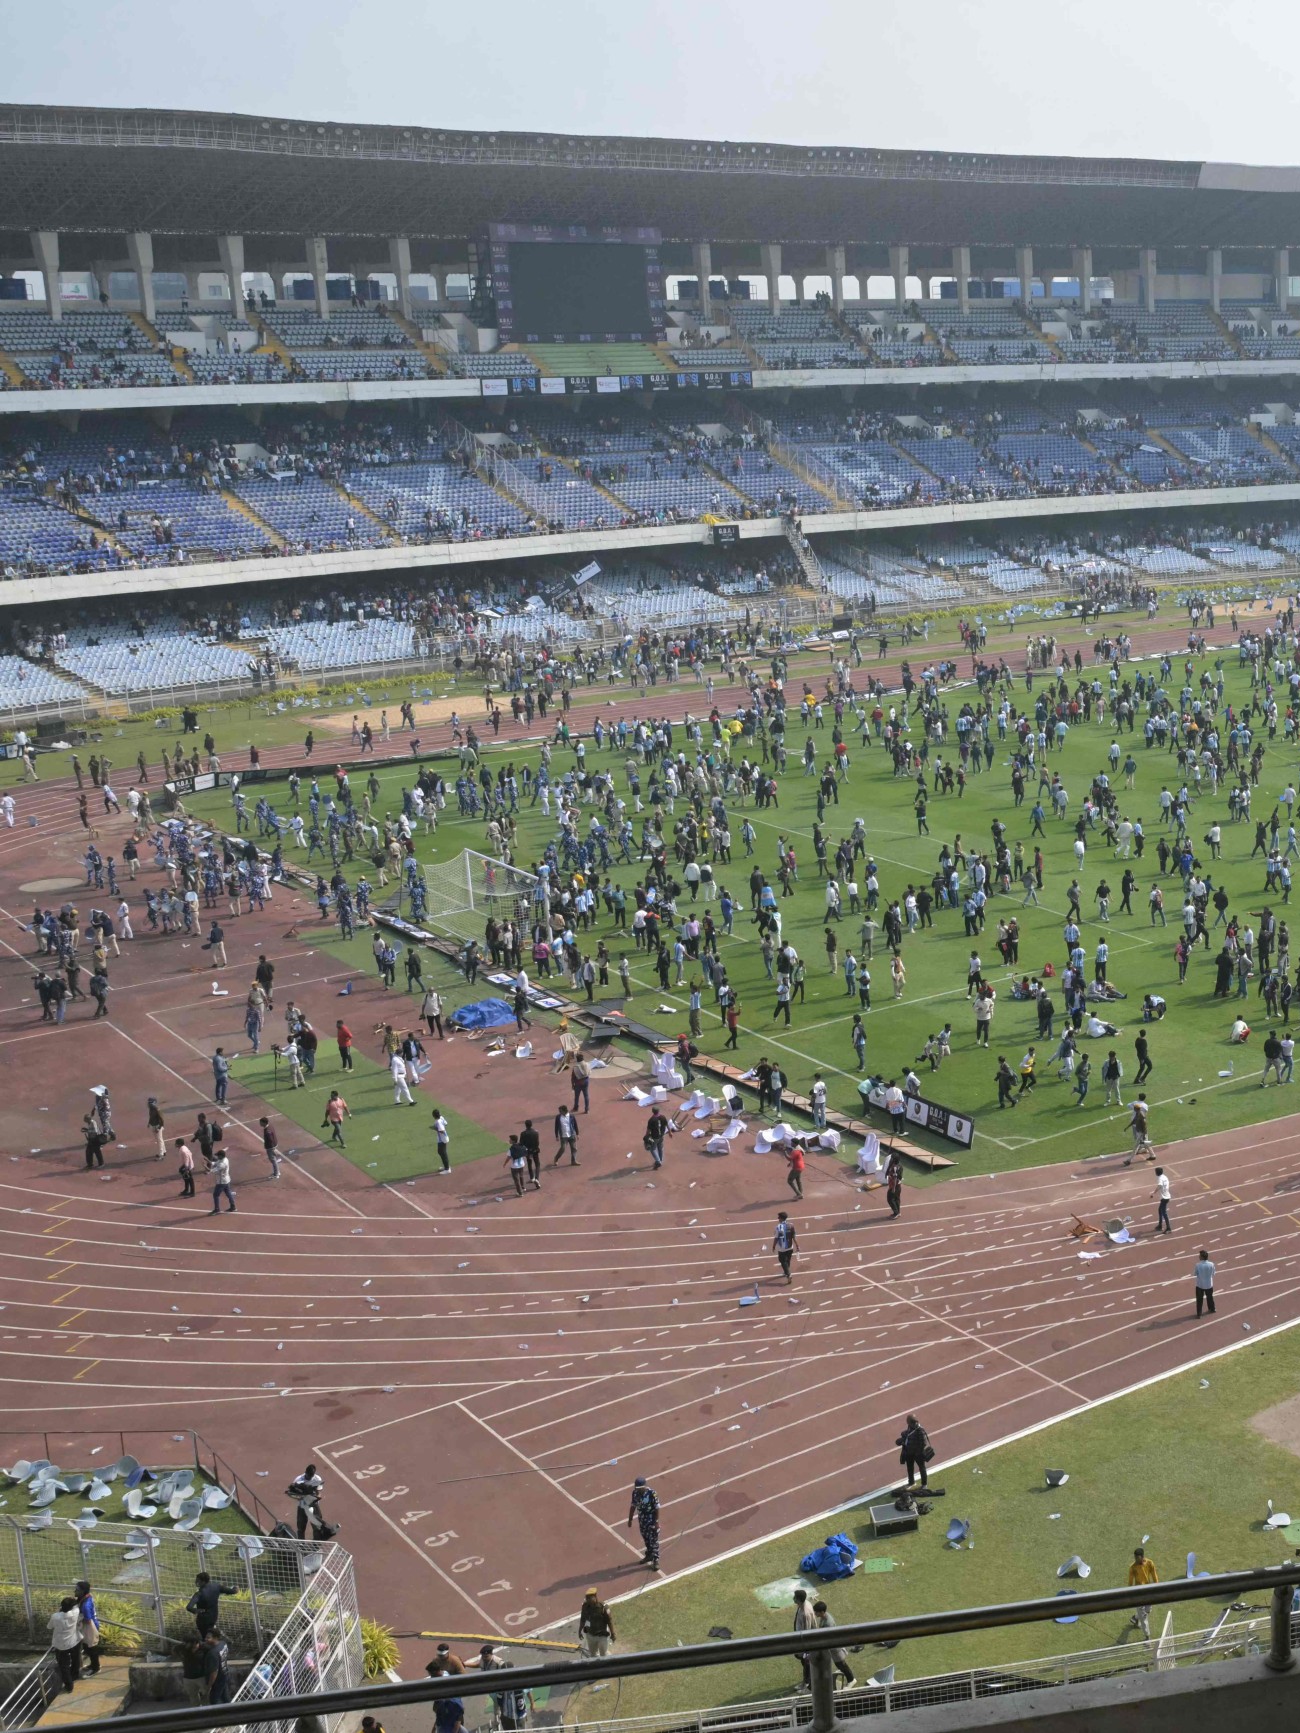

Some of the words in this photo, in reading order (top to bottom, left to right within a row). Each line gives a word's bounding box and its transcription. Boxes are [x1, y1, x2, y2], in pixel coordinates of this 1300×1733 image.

[331, 1444, 364, 1458] 1
[353, 1464, 386, 1480] 2
[376, 1485, 410, 1501] 3
[400, 1509, 433, 1525] 4
[424, 1530, 459, 1547] 5
[450, 1556, 485, 1573] 6
[477, 1579, 514, 1597] 7
[504, 1607, 539, 1626] 8
